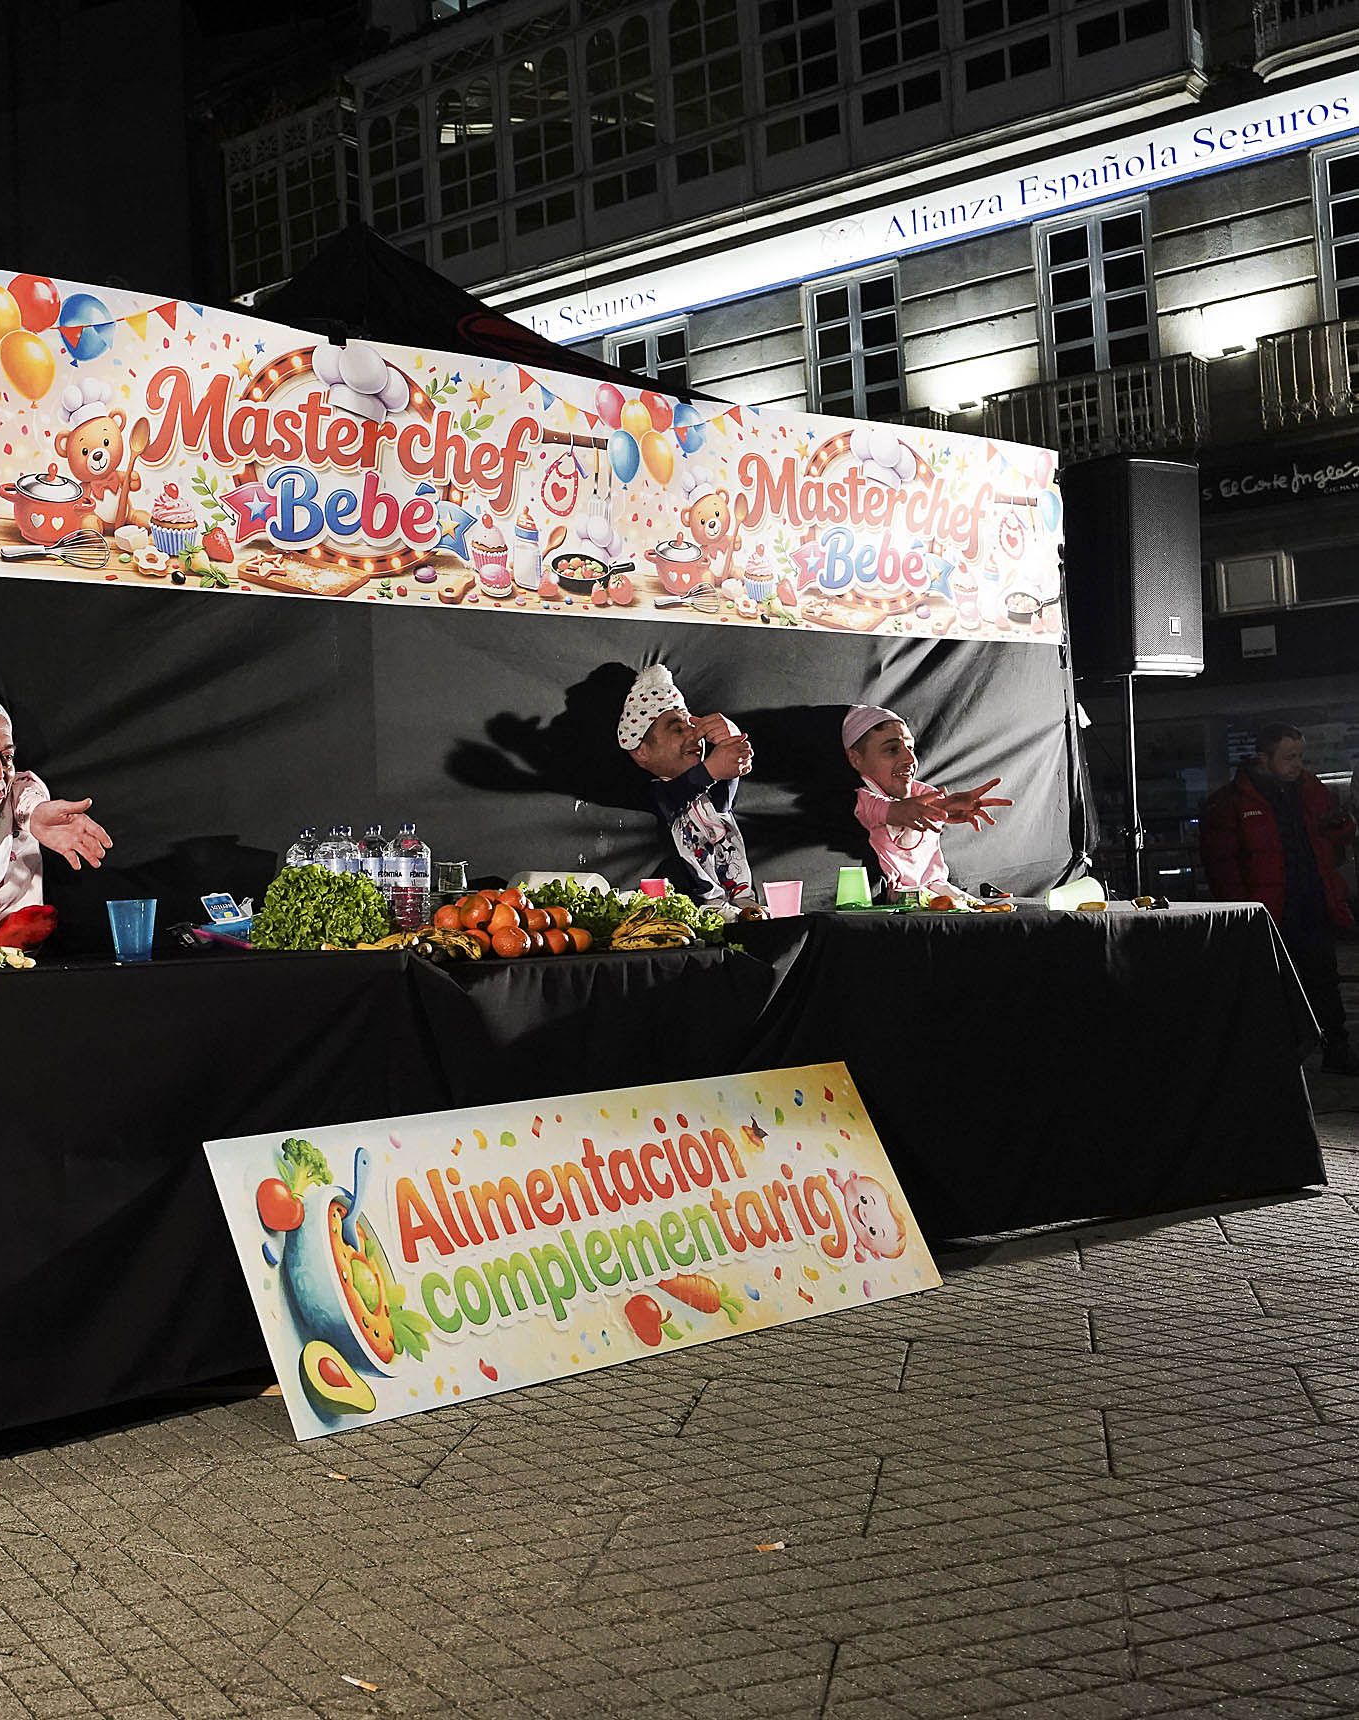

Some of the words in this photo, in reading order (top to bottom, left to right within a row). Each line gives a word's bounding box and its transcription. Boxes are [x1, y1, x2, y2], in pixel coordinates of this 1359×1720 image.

[884, 194, 1003, 242] Alianza
[1018, 142, 1178, 205] Española
[1192, 96, 1351, 158] Seguros
[559, 289, 656, 328] Seguros
[267, 466, 438, 544] Bebé
[1240, 474, 1288, 494] Corte
[819, 527, 928, 589] Bebé
[394, 1113, 747, 1264] Alimentación
